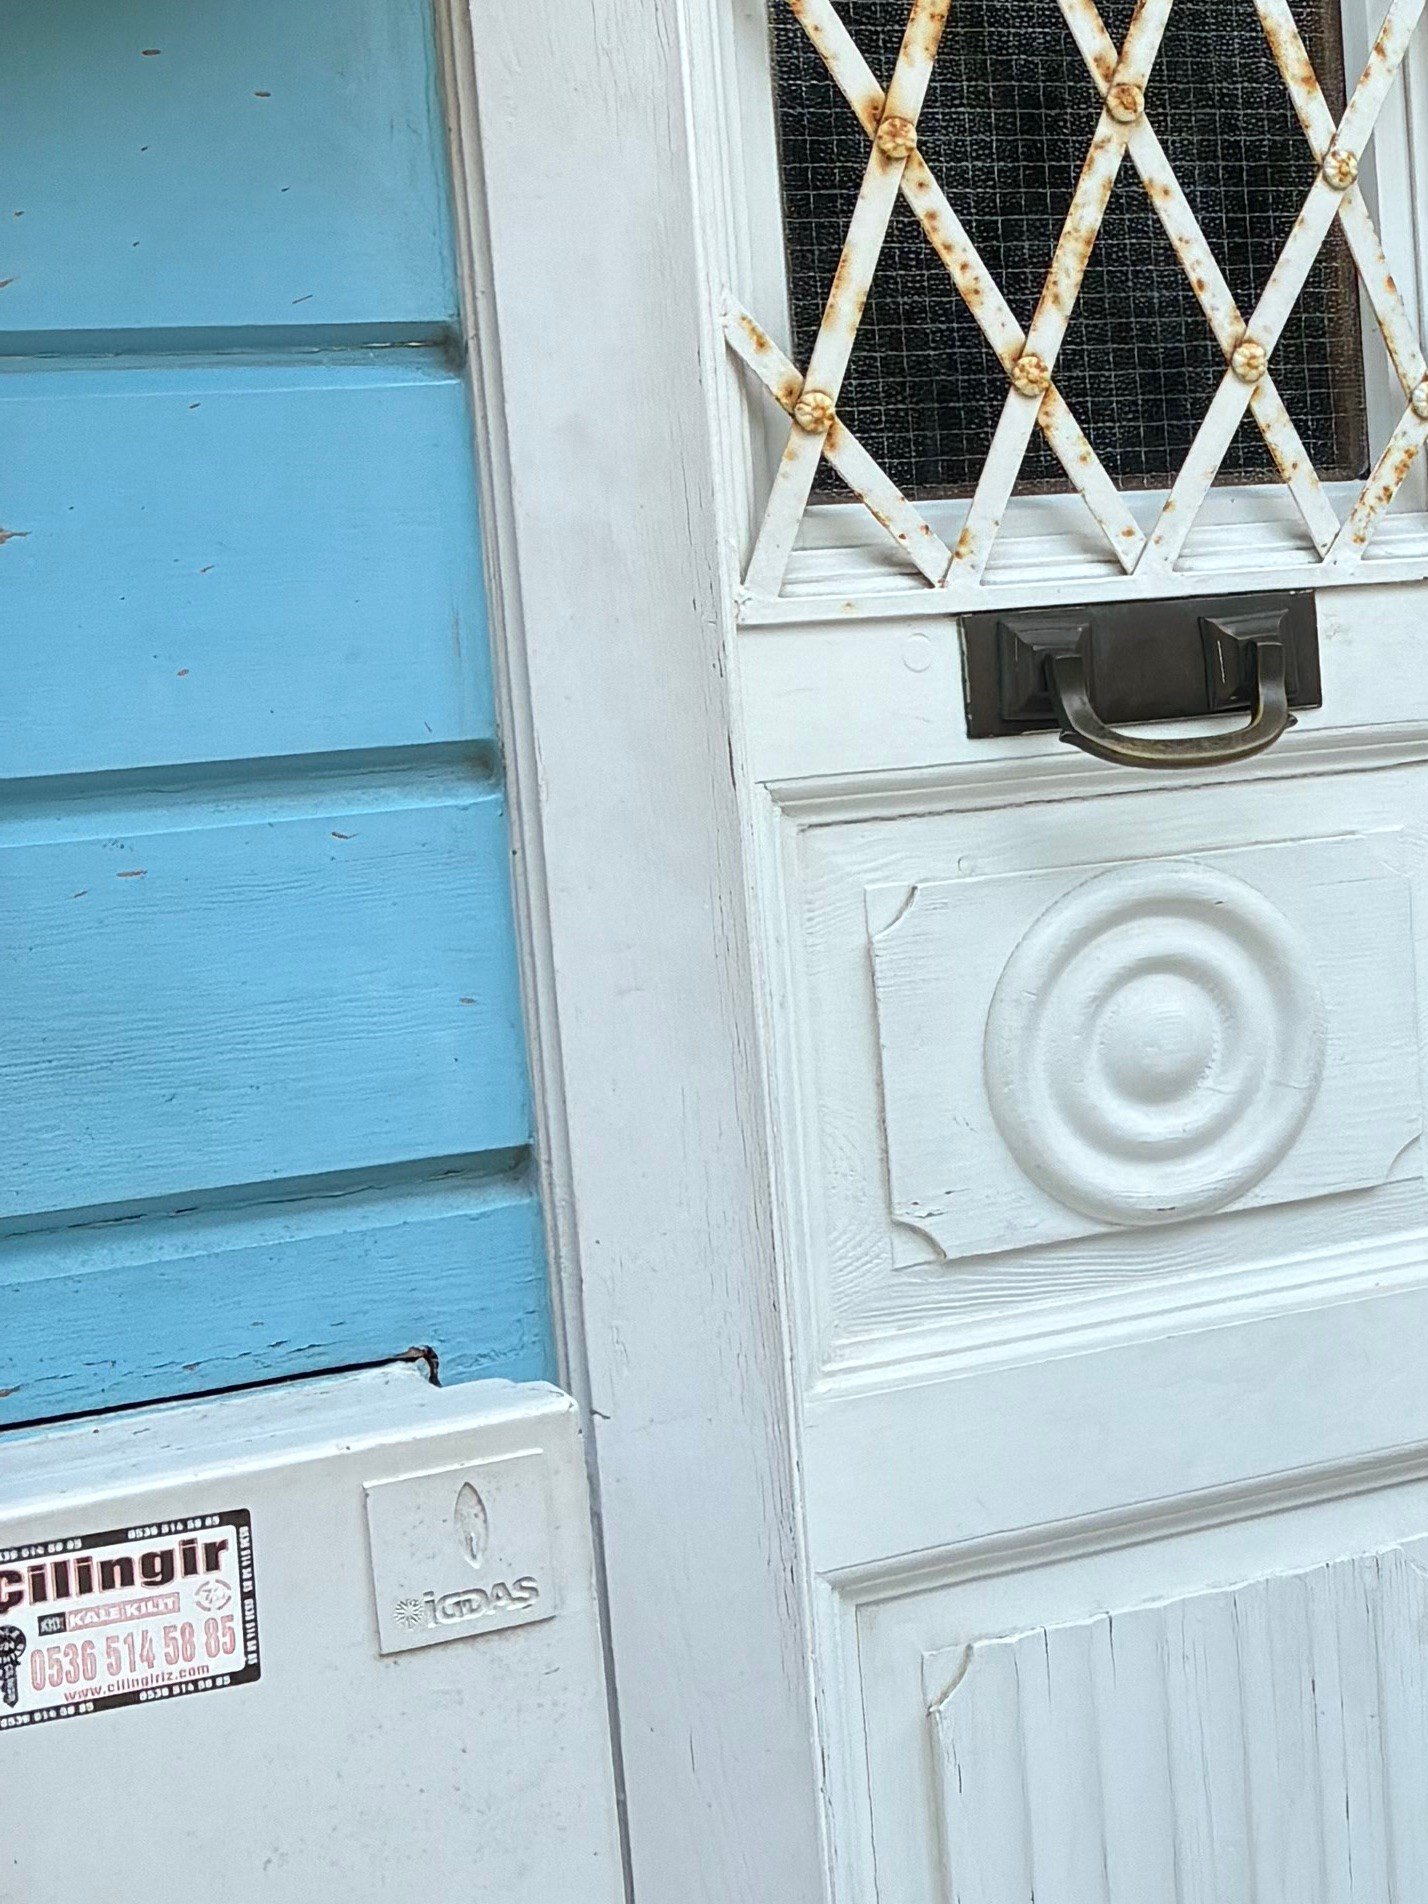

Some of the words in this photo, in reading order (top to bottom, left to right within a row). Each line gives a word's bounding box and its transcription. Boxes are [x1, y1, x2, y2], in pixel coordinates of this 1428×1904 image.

[30, 1639, 99, 1692] 0536
[104, 1629, 156, 1677] 514
[163, 1621, 196, 1666] 58
[204, 1614, 237, 1659] 85
